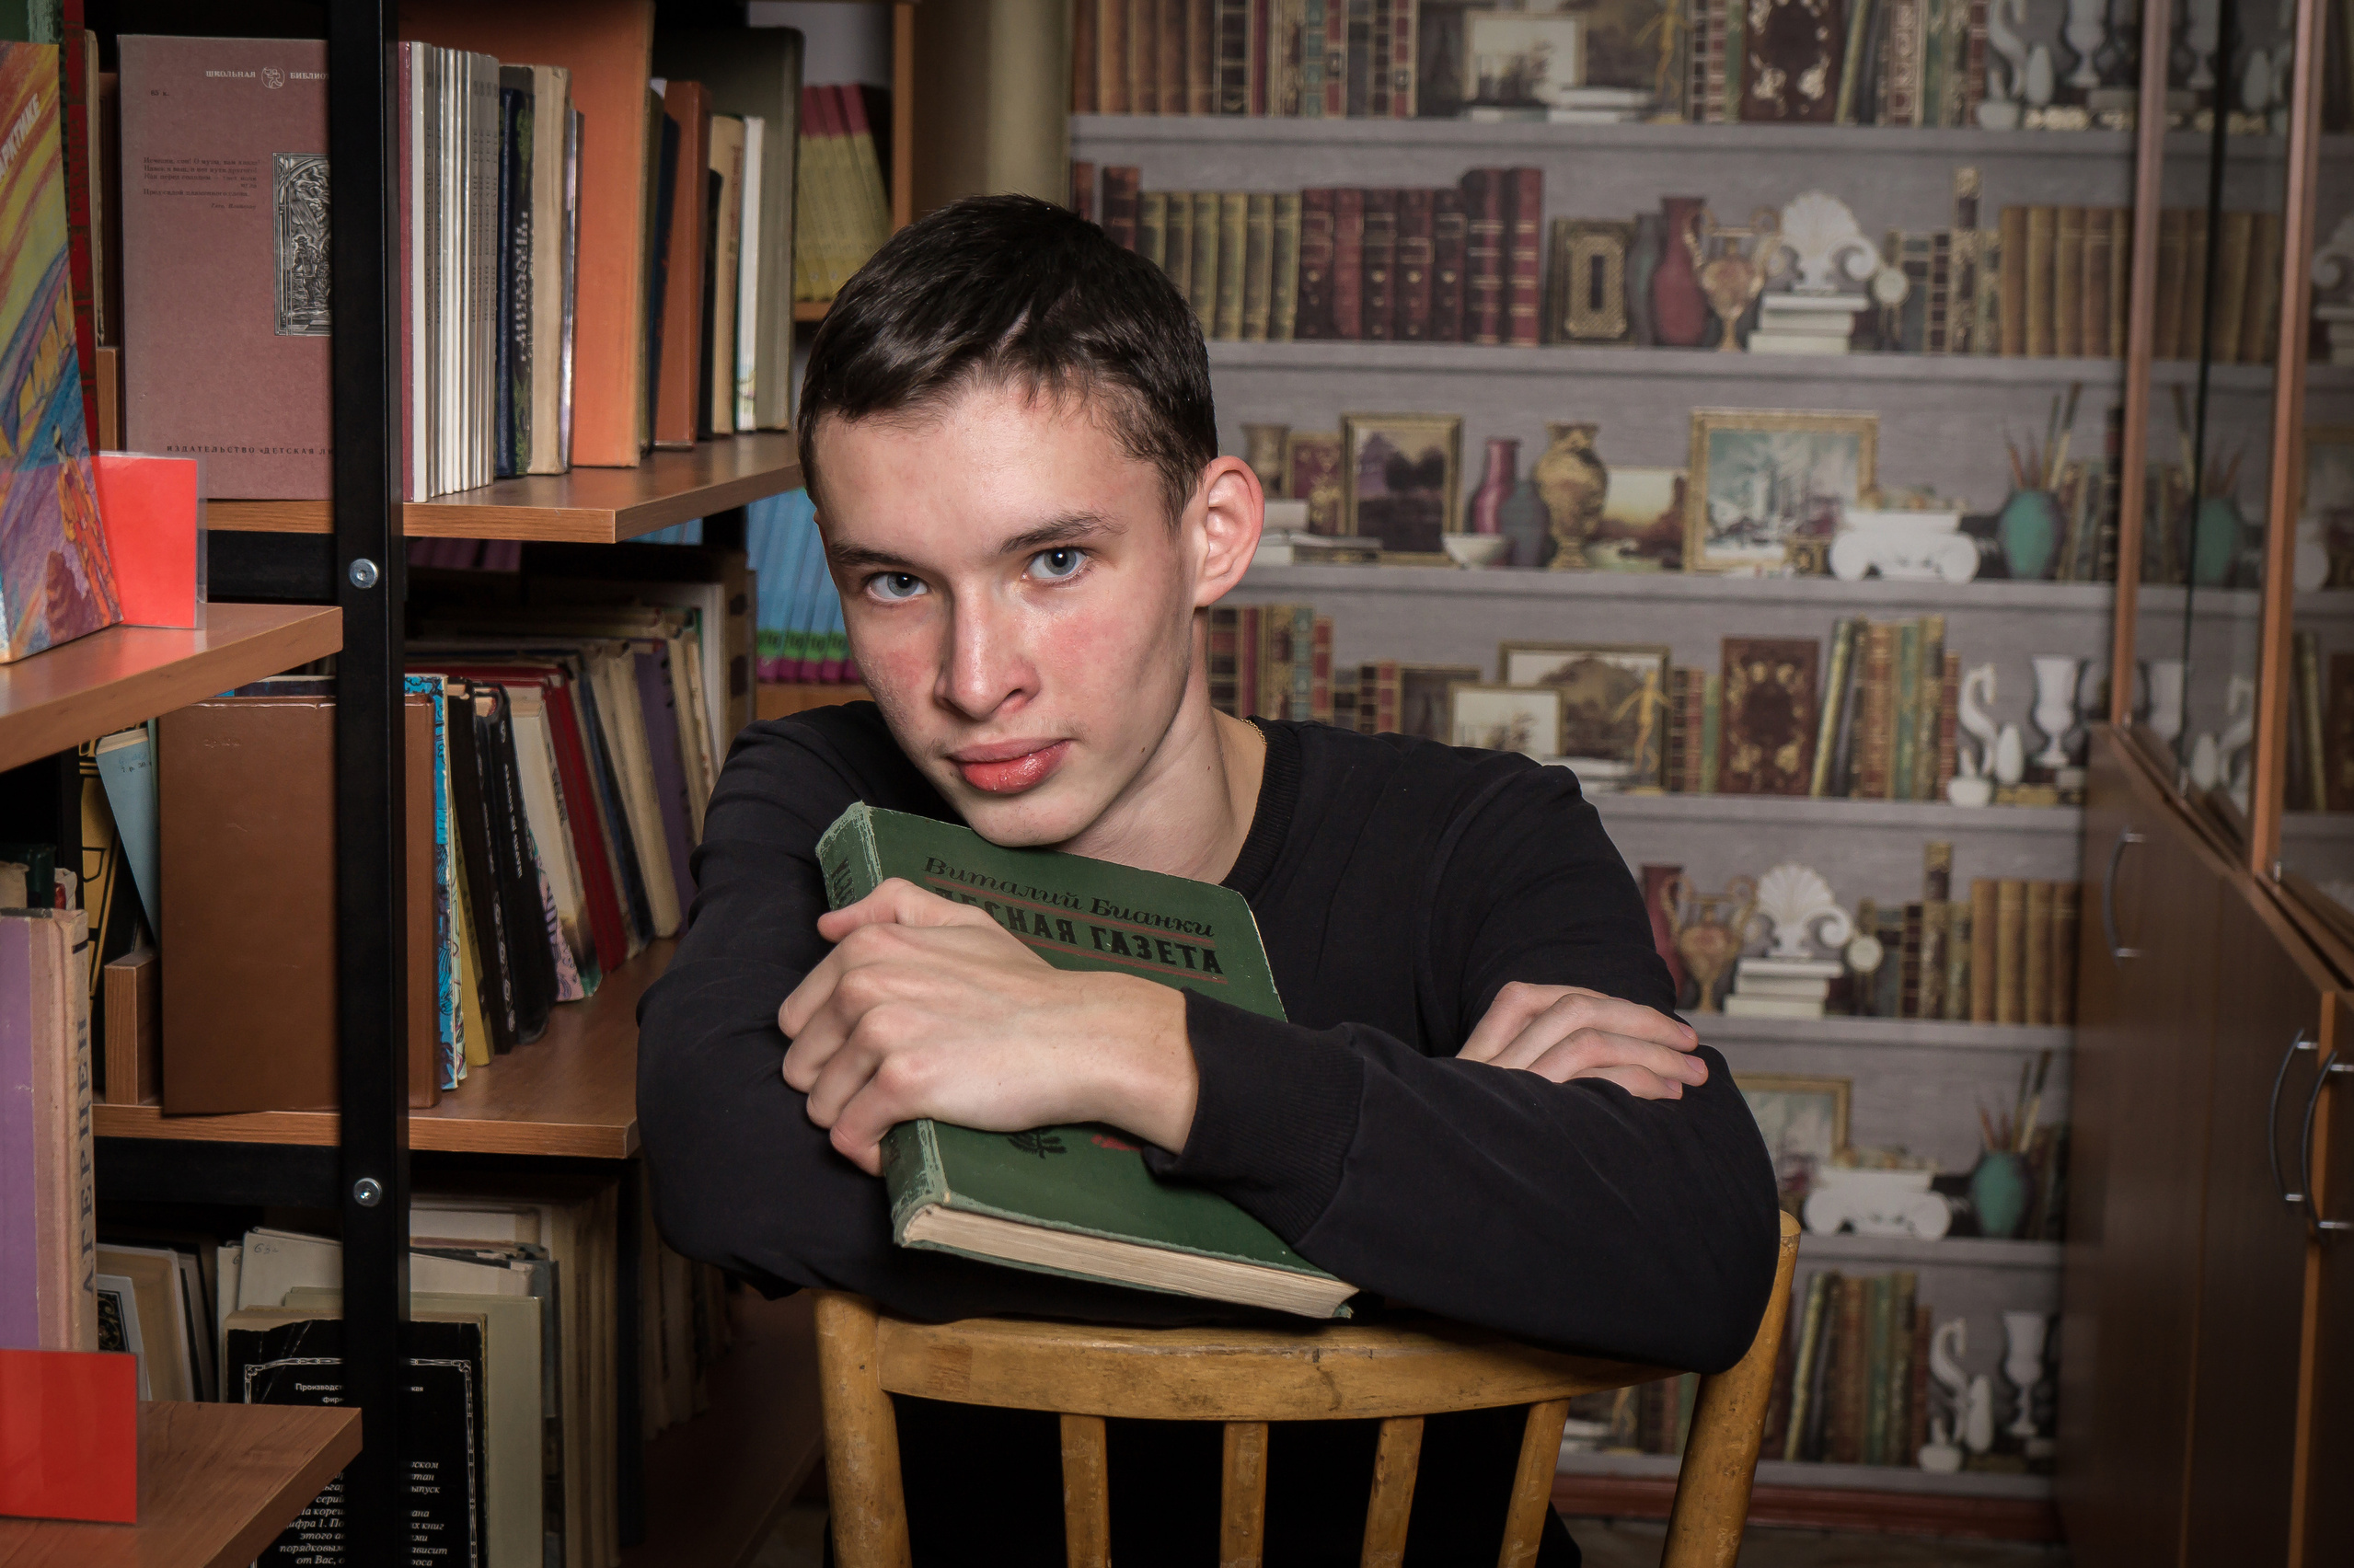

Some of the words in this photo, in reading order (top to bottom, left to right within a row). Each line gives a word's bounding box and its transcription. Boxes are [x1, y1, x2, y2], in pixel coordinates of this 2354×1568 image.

[206, 70, 256, 78] ШКОЛЬНАЯ
[167, 444, 256, 454] ИЗДАТЕЛЬСТВО
[922, 856, 1084, 911] Виталий
[1089, 896, 1216, 937] Бианки
[1090, 925, 1225, 975] ГАЗЕТА
[410, 1461, 439, 1470] ском
[410, 1473, 435, 1482] тан
[421, 1523, 445, 1531] книг
[299, 1532, 333, 1541] этого
[295, 1555, 312, 1565] от
[315, 1555, 337, 1566] Вас,
